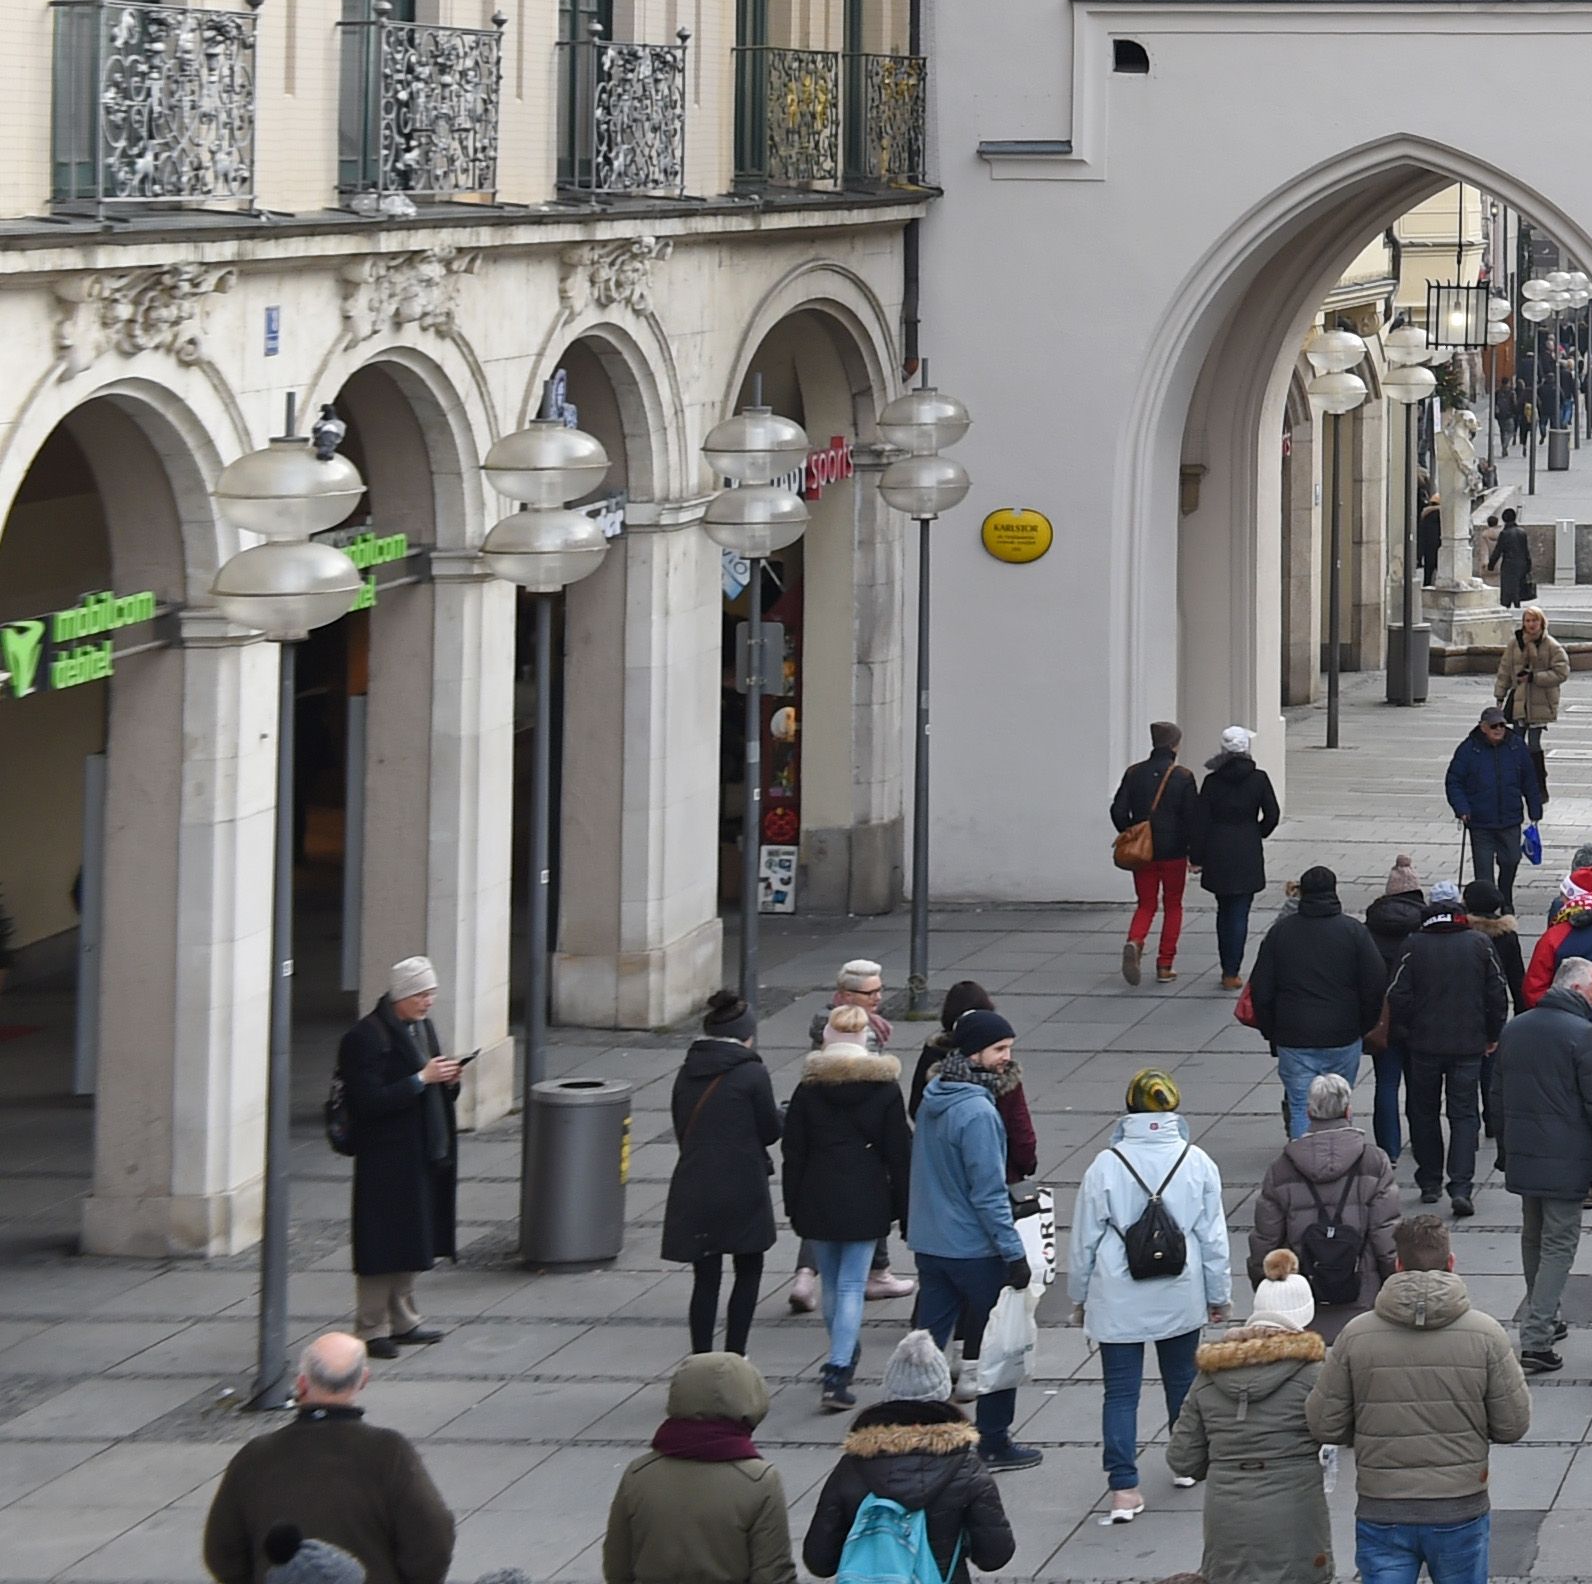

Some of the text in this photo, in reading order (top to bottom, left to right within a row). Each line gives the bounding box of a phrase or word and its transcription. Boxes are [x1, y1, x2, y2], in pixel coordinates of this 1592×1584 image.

[811, 437, 854, 500] sports
[341, 532, 407, 570] obilcom
[993, 523, 1039, 533] KARLSTOR
[53, 590, 156, 643] mobilcom
[52, 640, 114, 689] debitel
